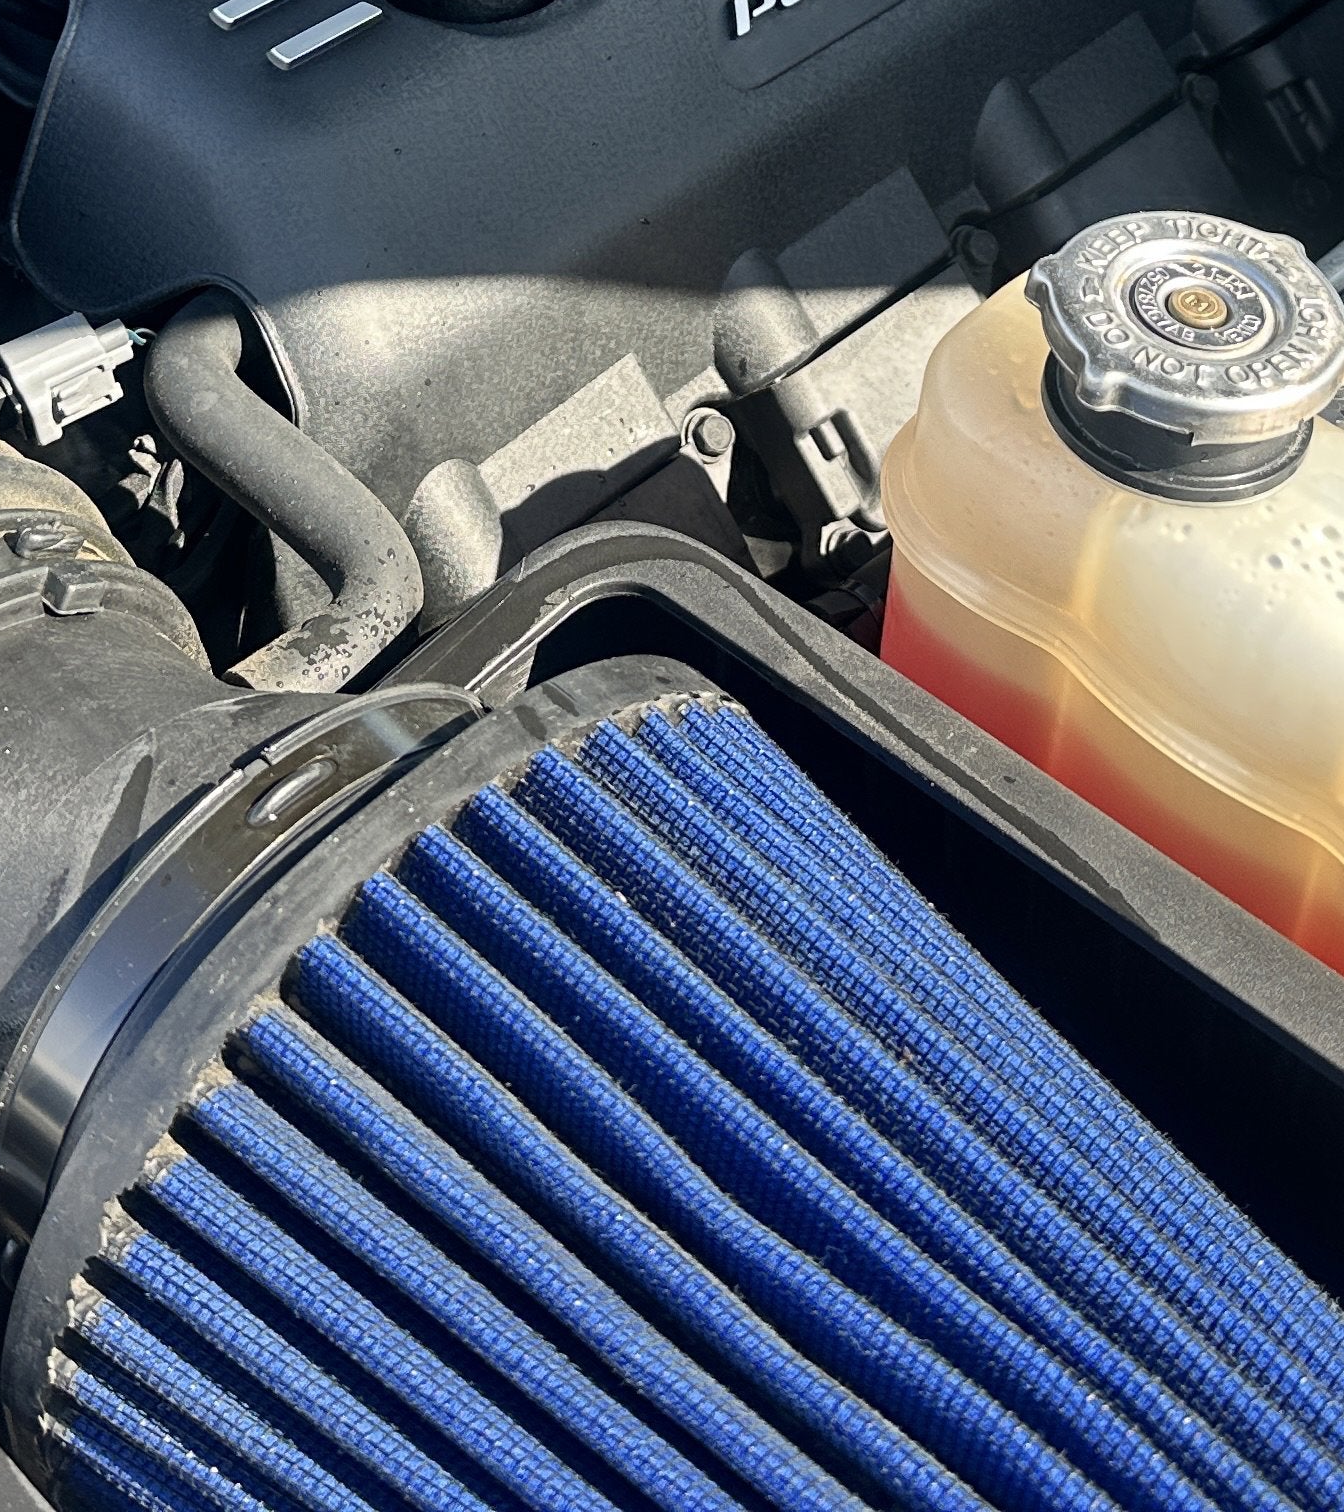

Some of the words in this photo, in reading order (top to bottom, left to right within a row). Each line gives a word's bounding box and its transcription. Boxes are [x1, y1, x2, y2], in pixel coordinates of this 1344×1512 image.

[1074, 220, 1150, 275] KEEP
[1083, 309, 1131, 349] DO
[1132, 344, 1213, 388] NOT
[1224, 341, 1316, 389] OPEN
